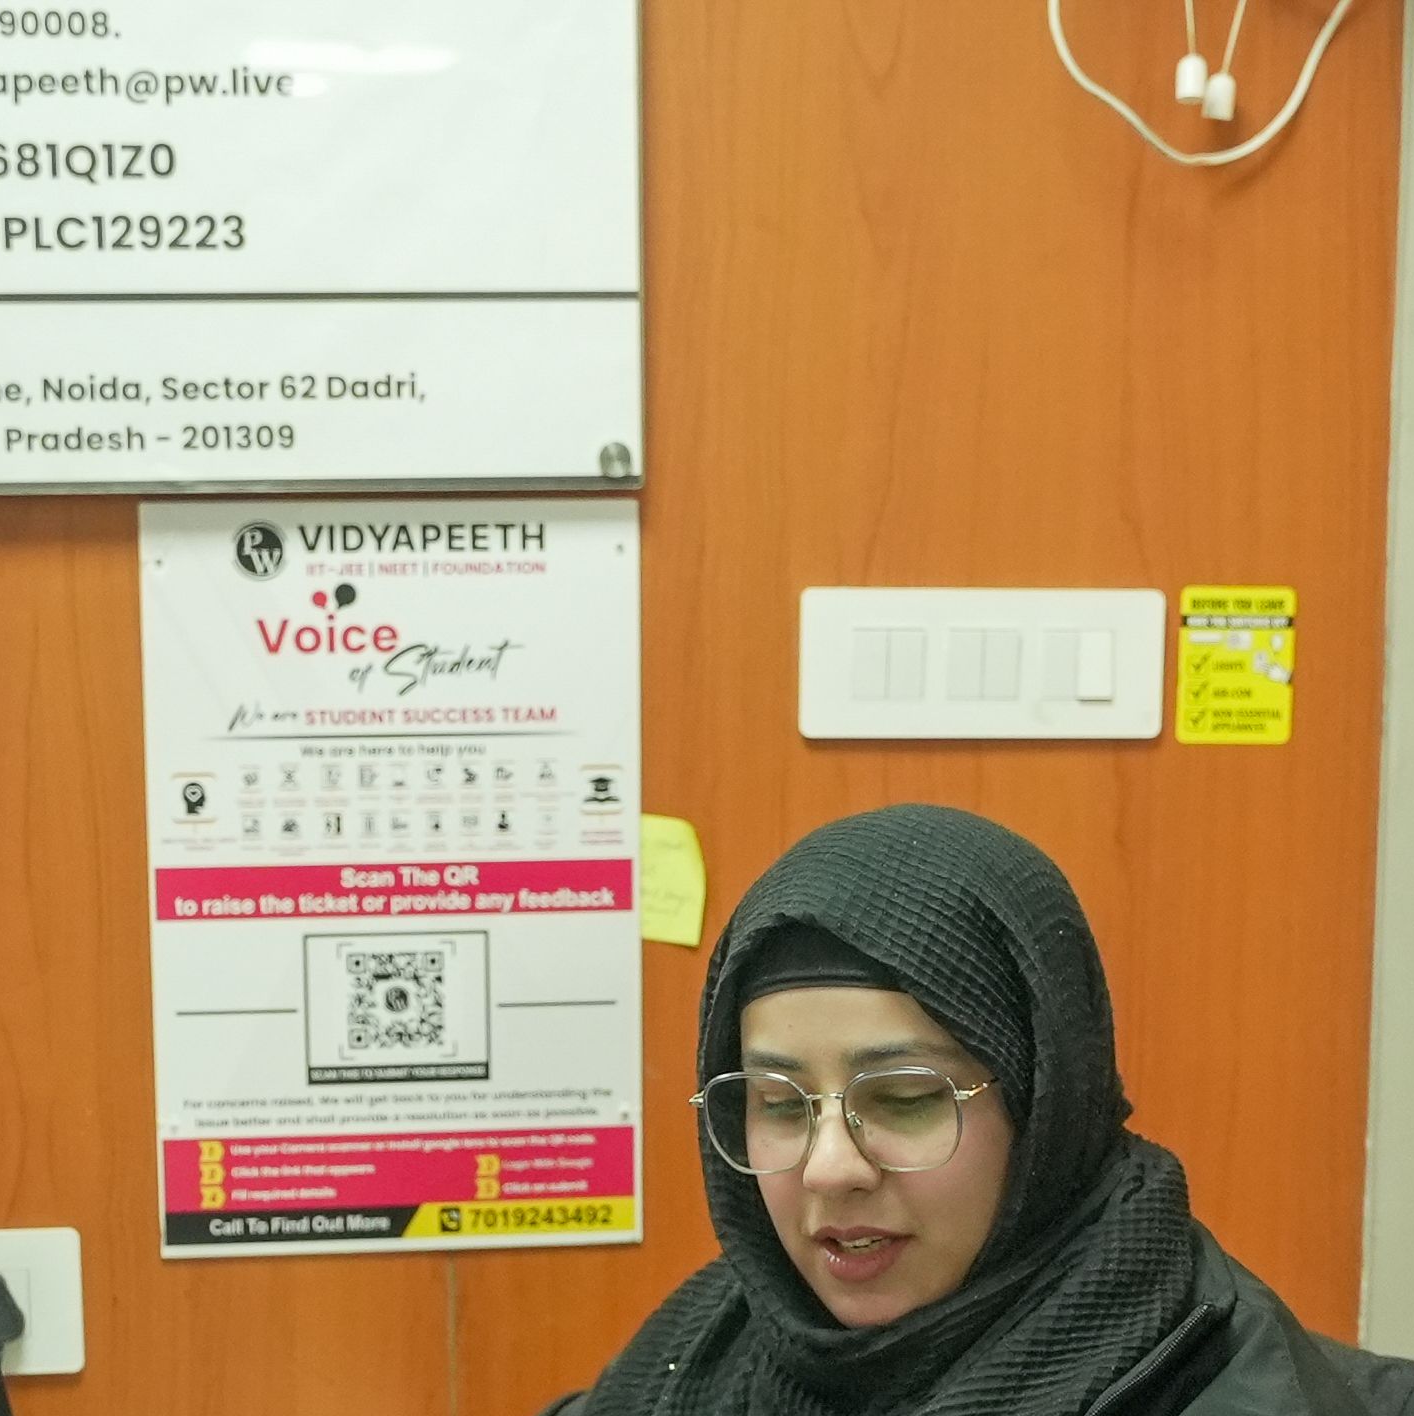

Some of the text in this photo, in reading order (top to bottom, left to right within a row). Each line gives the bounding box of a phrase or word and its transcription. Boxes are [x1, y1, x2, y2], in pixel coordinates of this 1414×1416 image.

[42, 374, 151, 405] Noida,
[161, 376, 270, 401] Sector
[279, 374, 317, 400] 62
[326, 372, 425, 401] Dadri,
[5, 425, 146, 453] Pradesh
[182, 424, 295, 450] 201309
[297, 522, 545, 551] VIDYAPEETH
[432, 561, 547, 576] FOUNDATION
[257, 614, 399, 654] Voice
[384, 638, 525, 696] Student
[305, 708, 395, 726] STUDENT
[403, 707, 496, 725] SUCCESS
[501, 706, 557, 723] TEAM
[457, 744, 486, 759] you
[340, 864, 480, 888] Scan The QR
[174, 887, 615, 917] to raise the ticket or provide any feedback
[209, 1213, 392, 1236] Call To Find Out More
[468, 1204, 613, 1228] 7019243492
